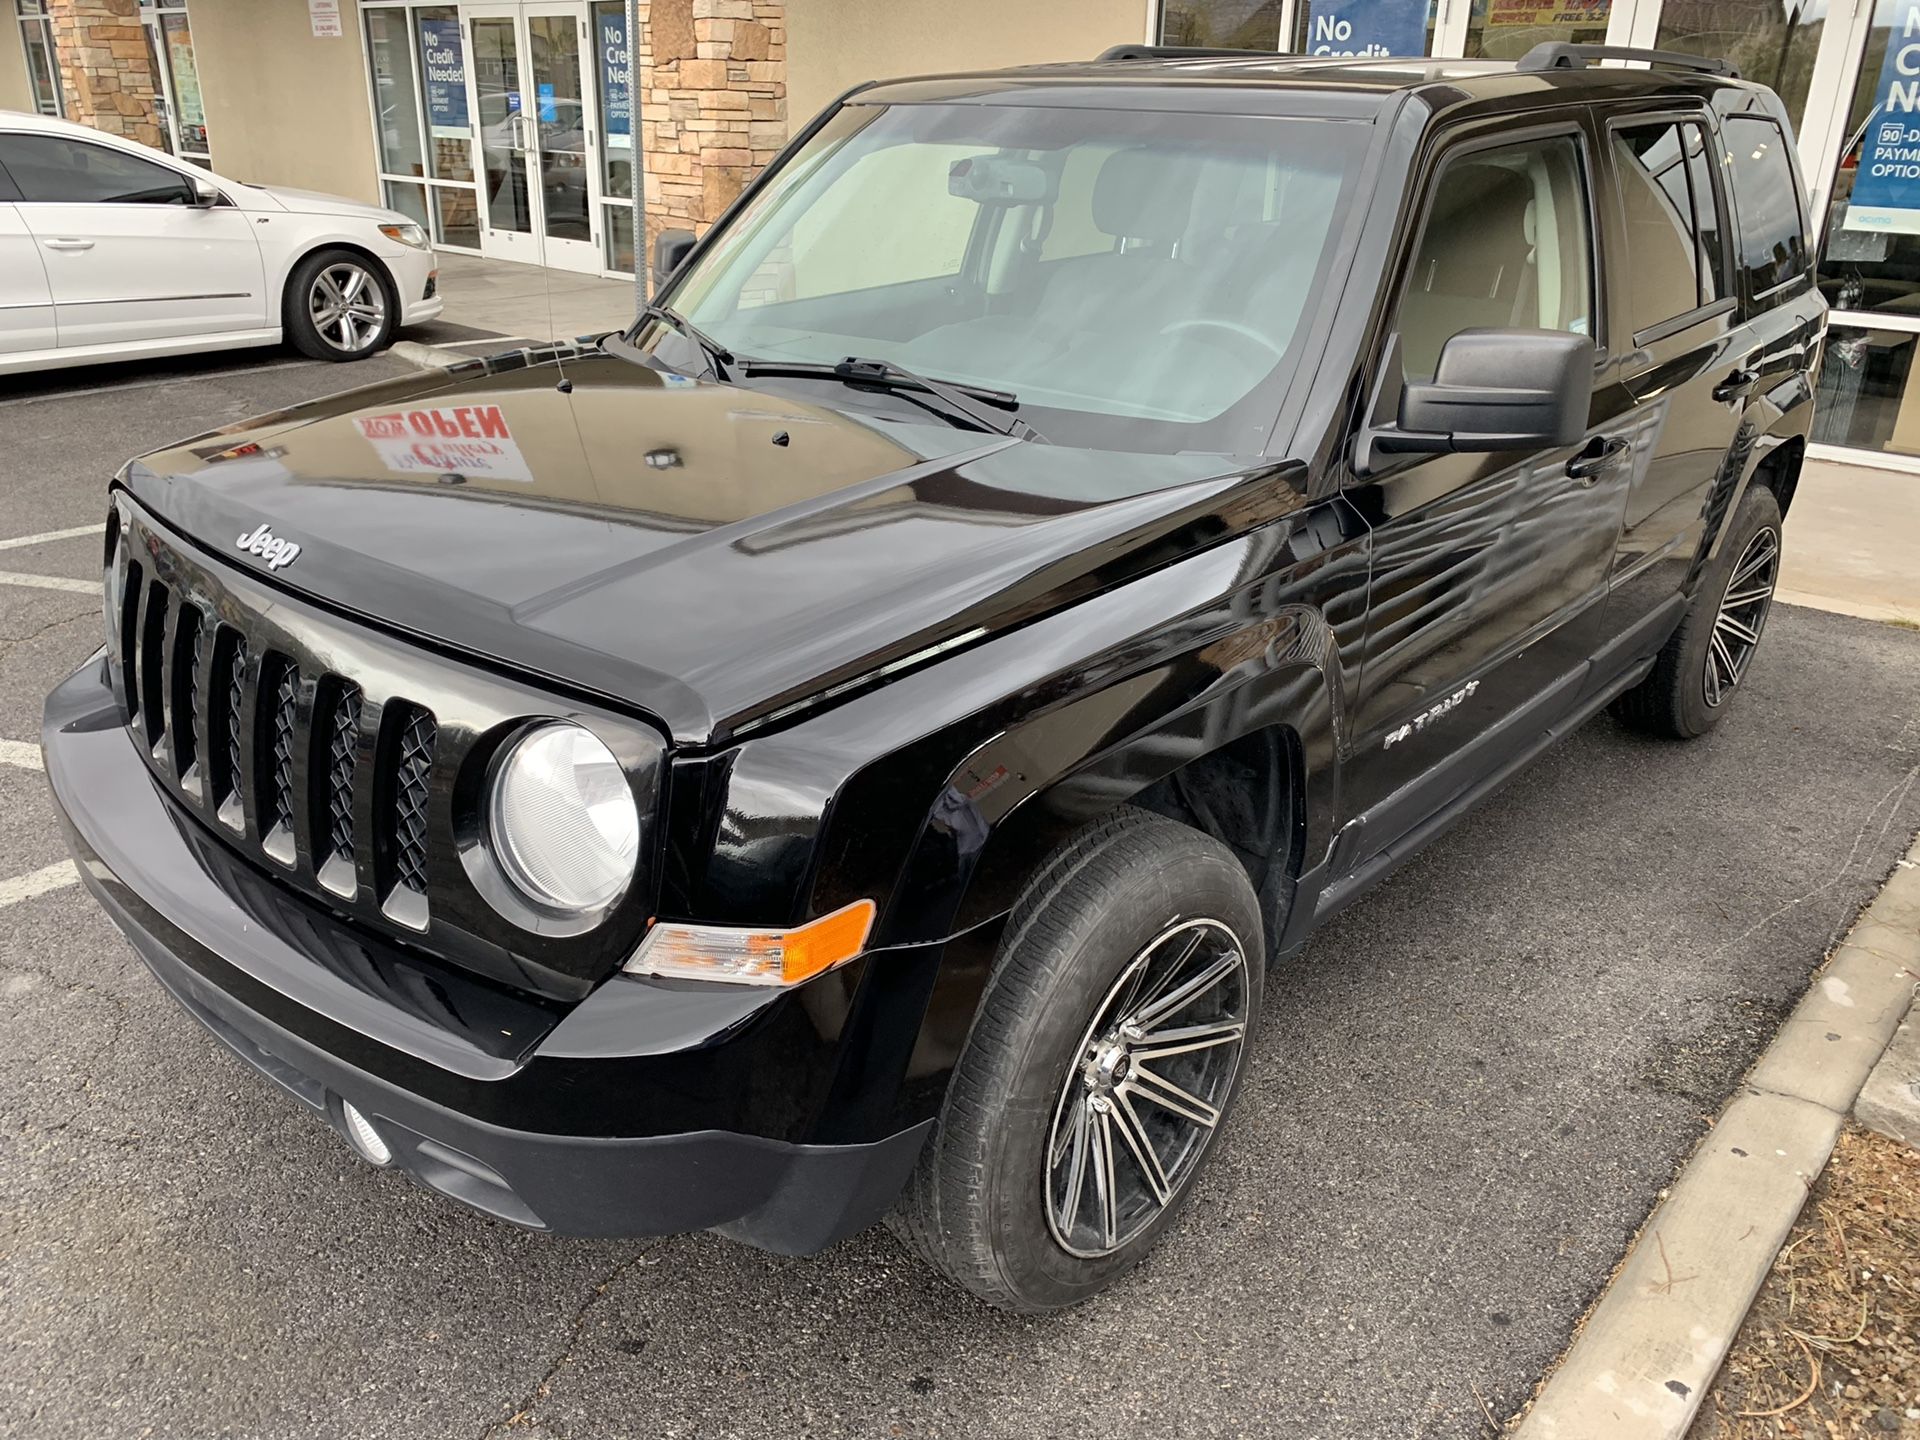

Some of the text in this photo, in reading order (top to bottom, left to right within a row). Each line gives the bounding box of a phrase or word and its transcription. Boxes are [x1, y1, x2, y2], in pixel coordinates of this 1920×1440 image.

[604, 26, 622, 44] No
[1315, 15, 1352, 41] No
[424, 31, 438, 46] No
[426, 48, 455, 64] Credit
[606, 46, 628, 64] Cre
[428, 66, 464, 82] Needed
[608, 66, 630, 84] Nee
[1882, 128, 1920, 143] 90-D
[1874, 147, 1920, 162] PAYM
[1871, 163, 1920, 179] OPTIO
[236, 523, 301, 571] Jeep
[1384, 680, 1480, 750] PATRIOT
